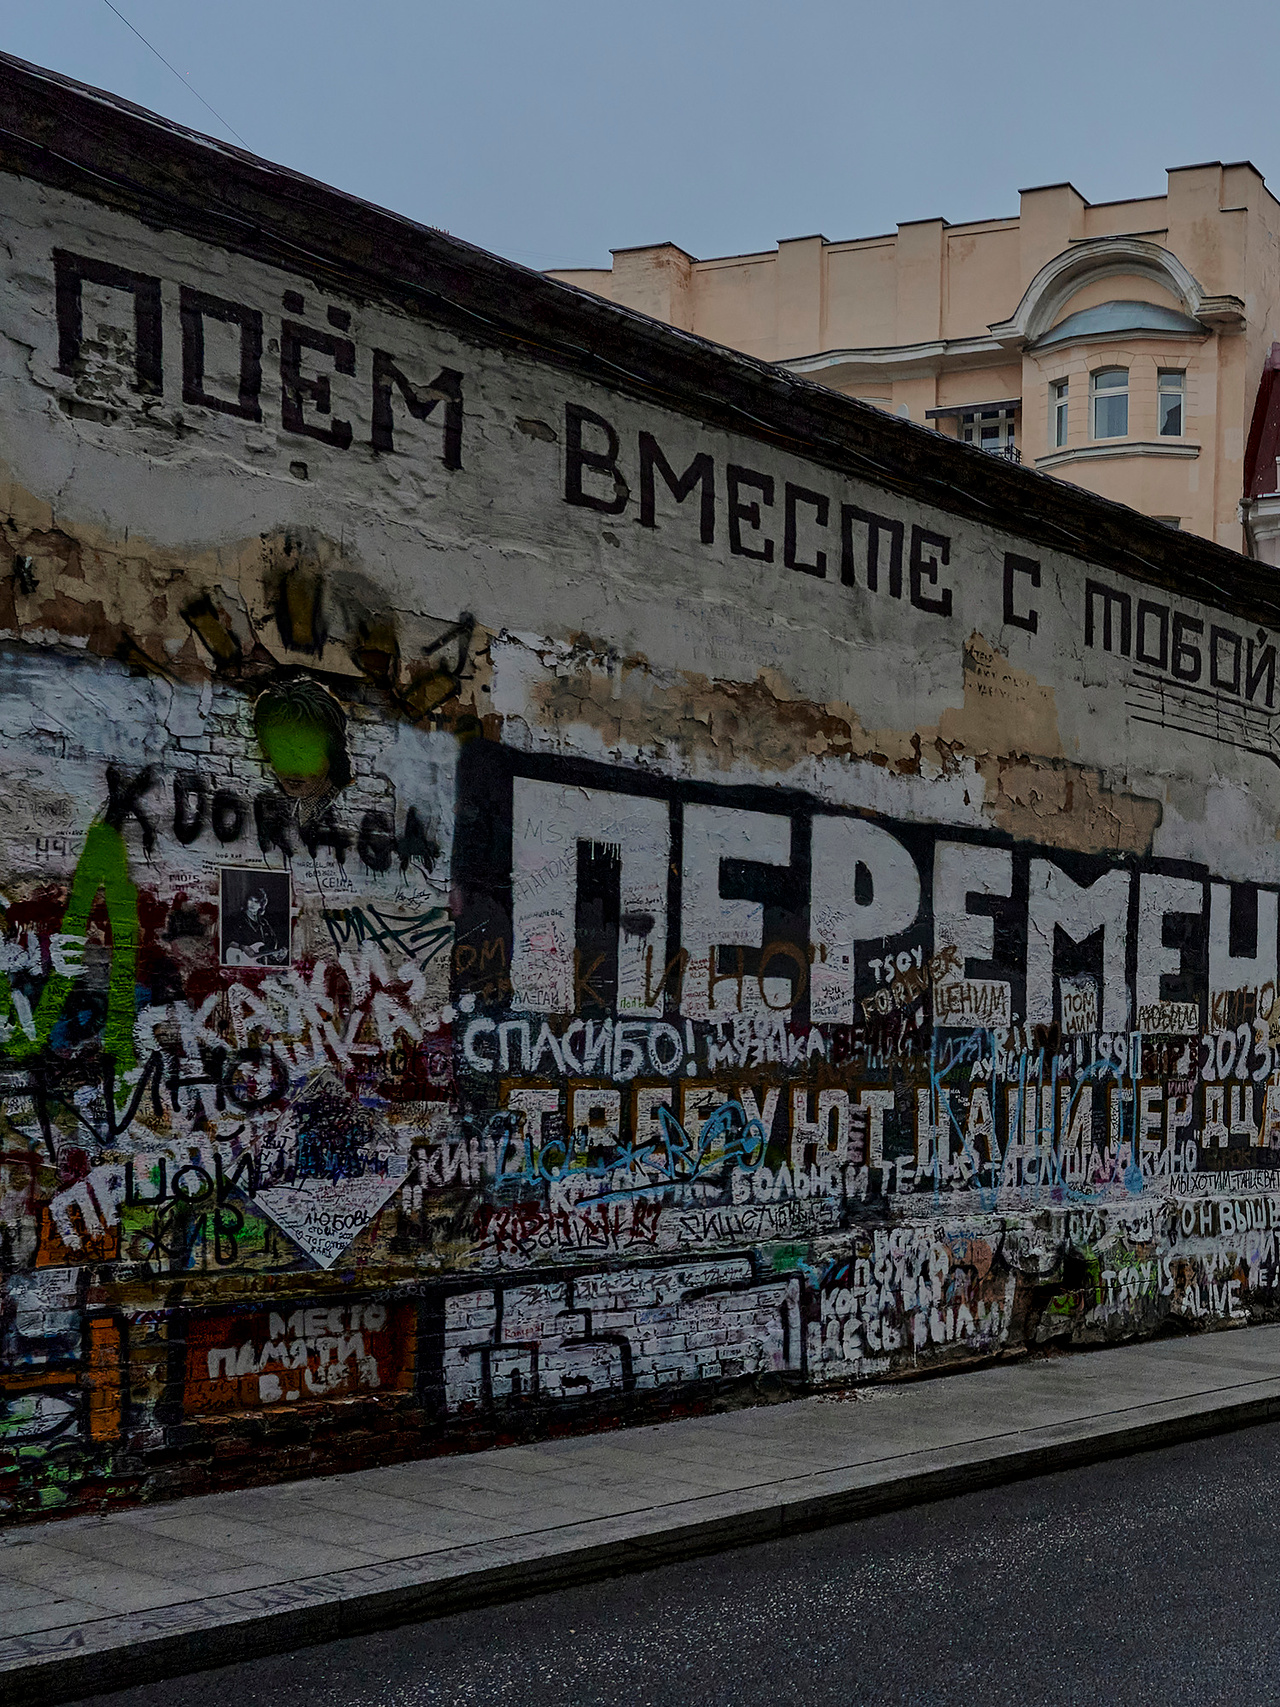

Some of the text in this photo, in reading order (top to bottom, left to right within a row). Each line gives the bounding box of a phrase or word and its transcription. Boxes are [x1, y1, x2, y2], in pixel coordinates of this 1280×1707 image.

[53, 247, 1276, 709] ПОЁМ ВМЕСТЕ С ТОБОЙ
[868, 945, 923, 984] TSOY
[463, 1014, 698, 1083] СПАСИБО!
[1202, 1021, 1272, 1082] 2023
[1170, 1174, 1190, 1195] МЫ
[1190, 1172, 1230, 1194] ХОТИМ
[304, 1210, 373, 1232] ЛЮБОВЬ
[1180, 1202, 1214, 1239] ОН
[1101, 1256, 1175, 1308] TSOY IS
[268, 1304, 388, 1340] МЕСТО
[207, 1331, 366, 1380] ПАМЯТИ
